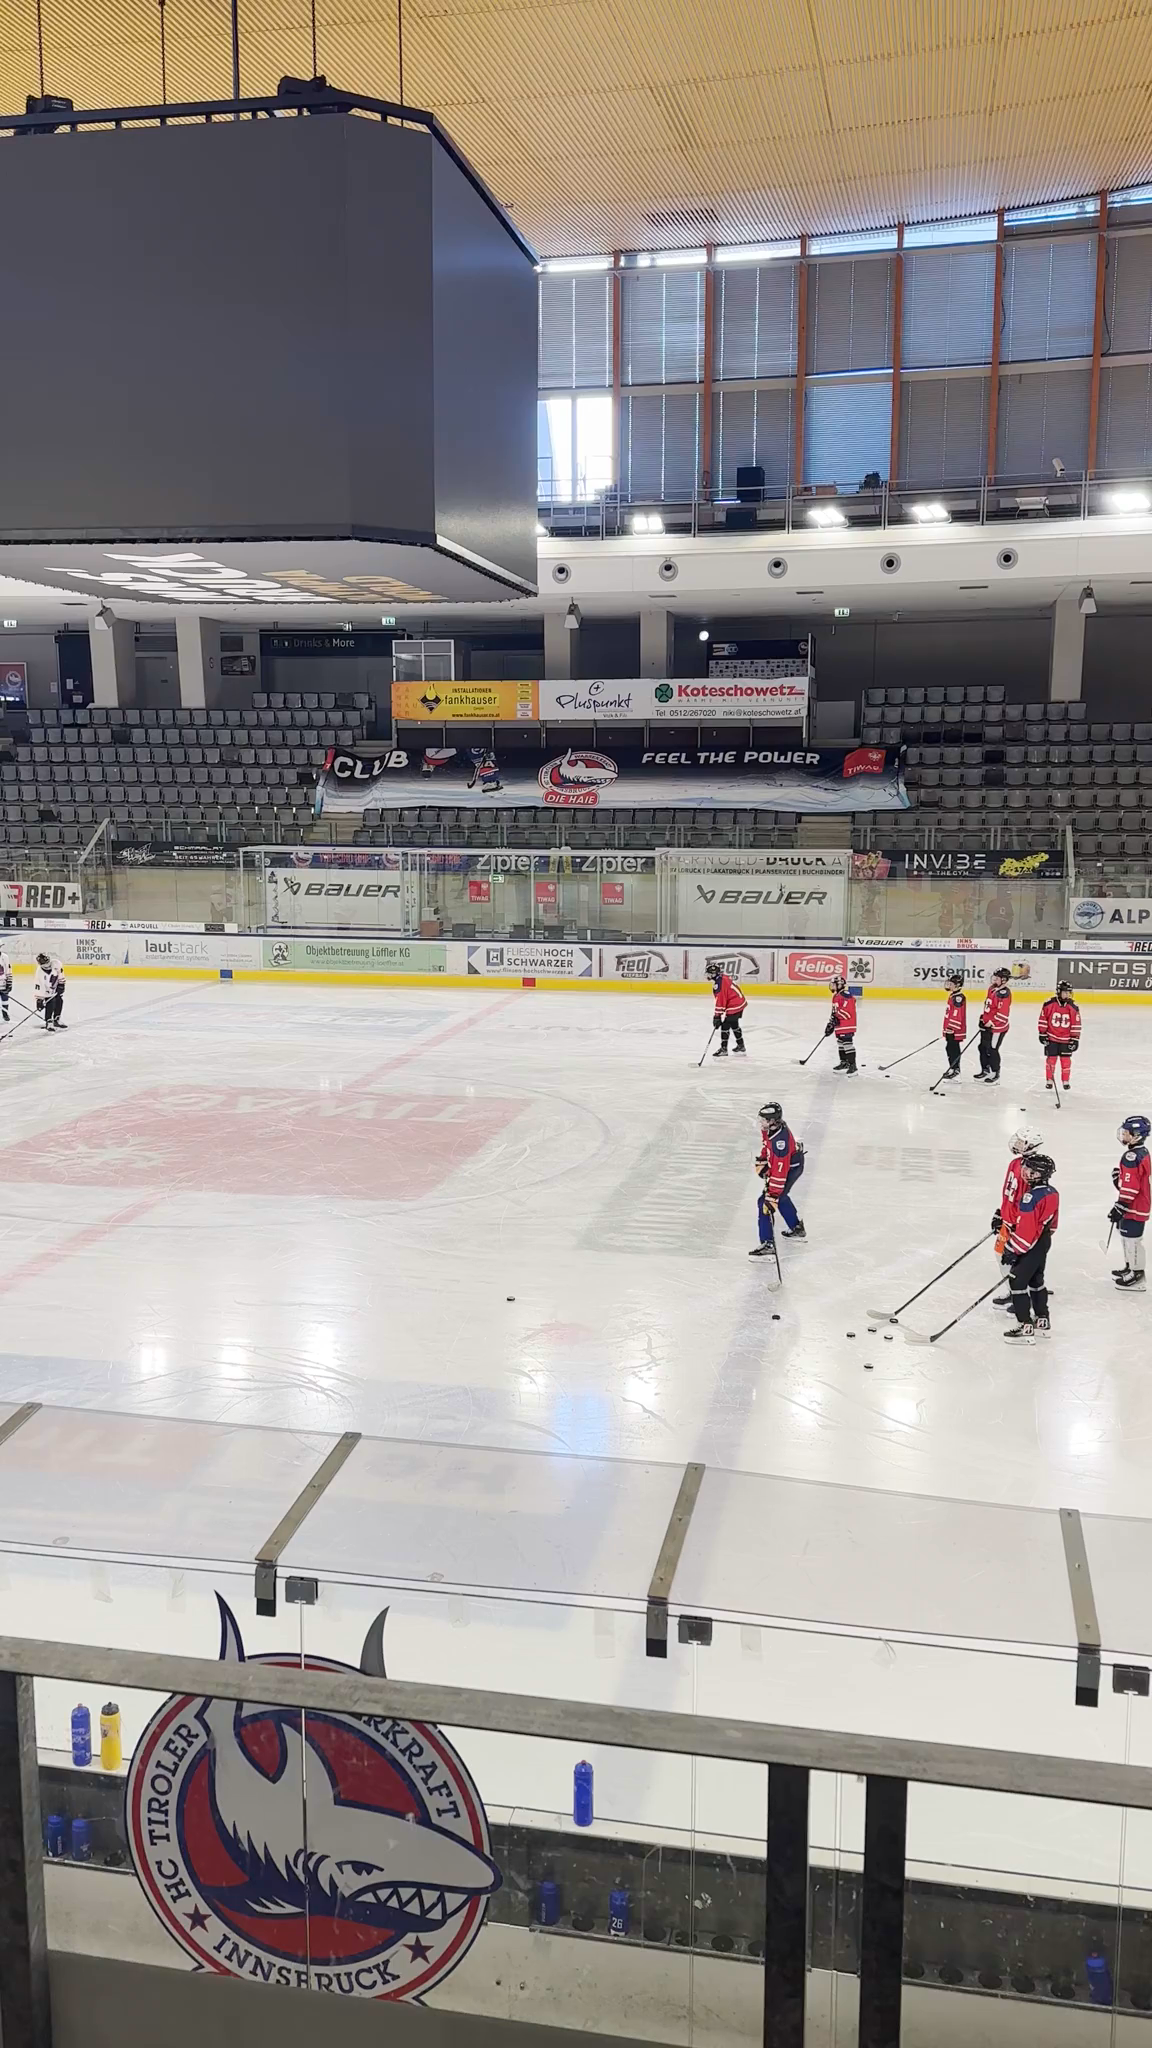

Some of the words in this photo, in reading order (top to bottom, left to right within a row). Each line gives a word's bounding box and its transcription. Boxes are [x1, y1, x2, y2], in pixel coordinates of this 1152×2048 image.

[293, 637, 323, 647] Drinks
[332, 638, 355, 648] More
[677, 683, 804, 697] Koteschowetz
[445, 693, 497, 705] fankhauser
[556, 693, 632, 711] Pluspunkt
[669, 709, 717, 717] 0512/267020
[722, 707, 802, 718] niki@koteschowetz.at
[334, 750, 409, 779] CLUB
[641, 753, 691, 765] FEEL
[697, 751, 737, 764] THE
[743, 752, 820, 765] POWER
[546, 794, 566, 803] DIE
[567, 795, 595, 804] HAIE
[905, 853, 986, 869] INVIBE
[304, 882, 400, 898] BAUER
[719, 890, 827, 905] BAUER
[1109, 909, 1151, 924] ALP
[145, 939, 208, 954] lautstark
[306, 945, 369, 960] Objektbetreuung
[371, 945, 397, 958] Löffler
[399, 947, 411, 958] KG
[506, 947, 574, 958] FLIESENHOCH
[76, 953, 111, 961] AIRPORT
[506, 957, 574, 968] SCHWARZER
[794, 959, 844, 975] Helios
[913, 965, 985, 981] systemic
[1070, 961, 1152, 975] INFOS
[1110, 978, 1139, 988] DEIN
[147, 1722, 200, 1847] TIROLER
[155, 1858, 193, 1904] HC
[611, 1917, 623, 1929] 26
[213, 1932, 401, 1995] INNSBRUCK
